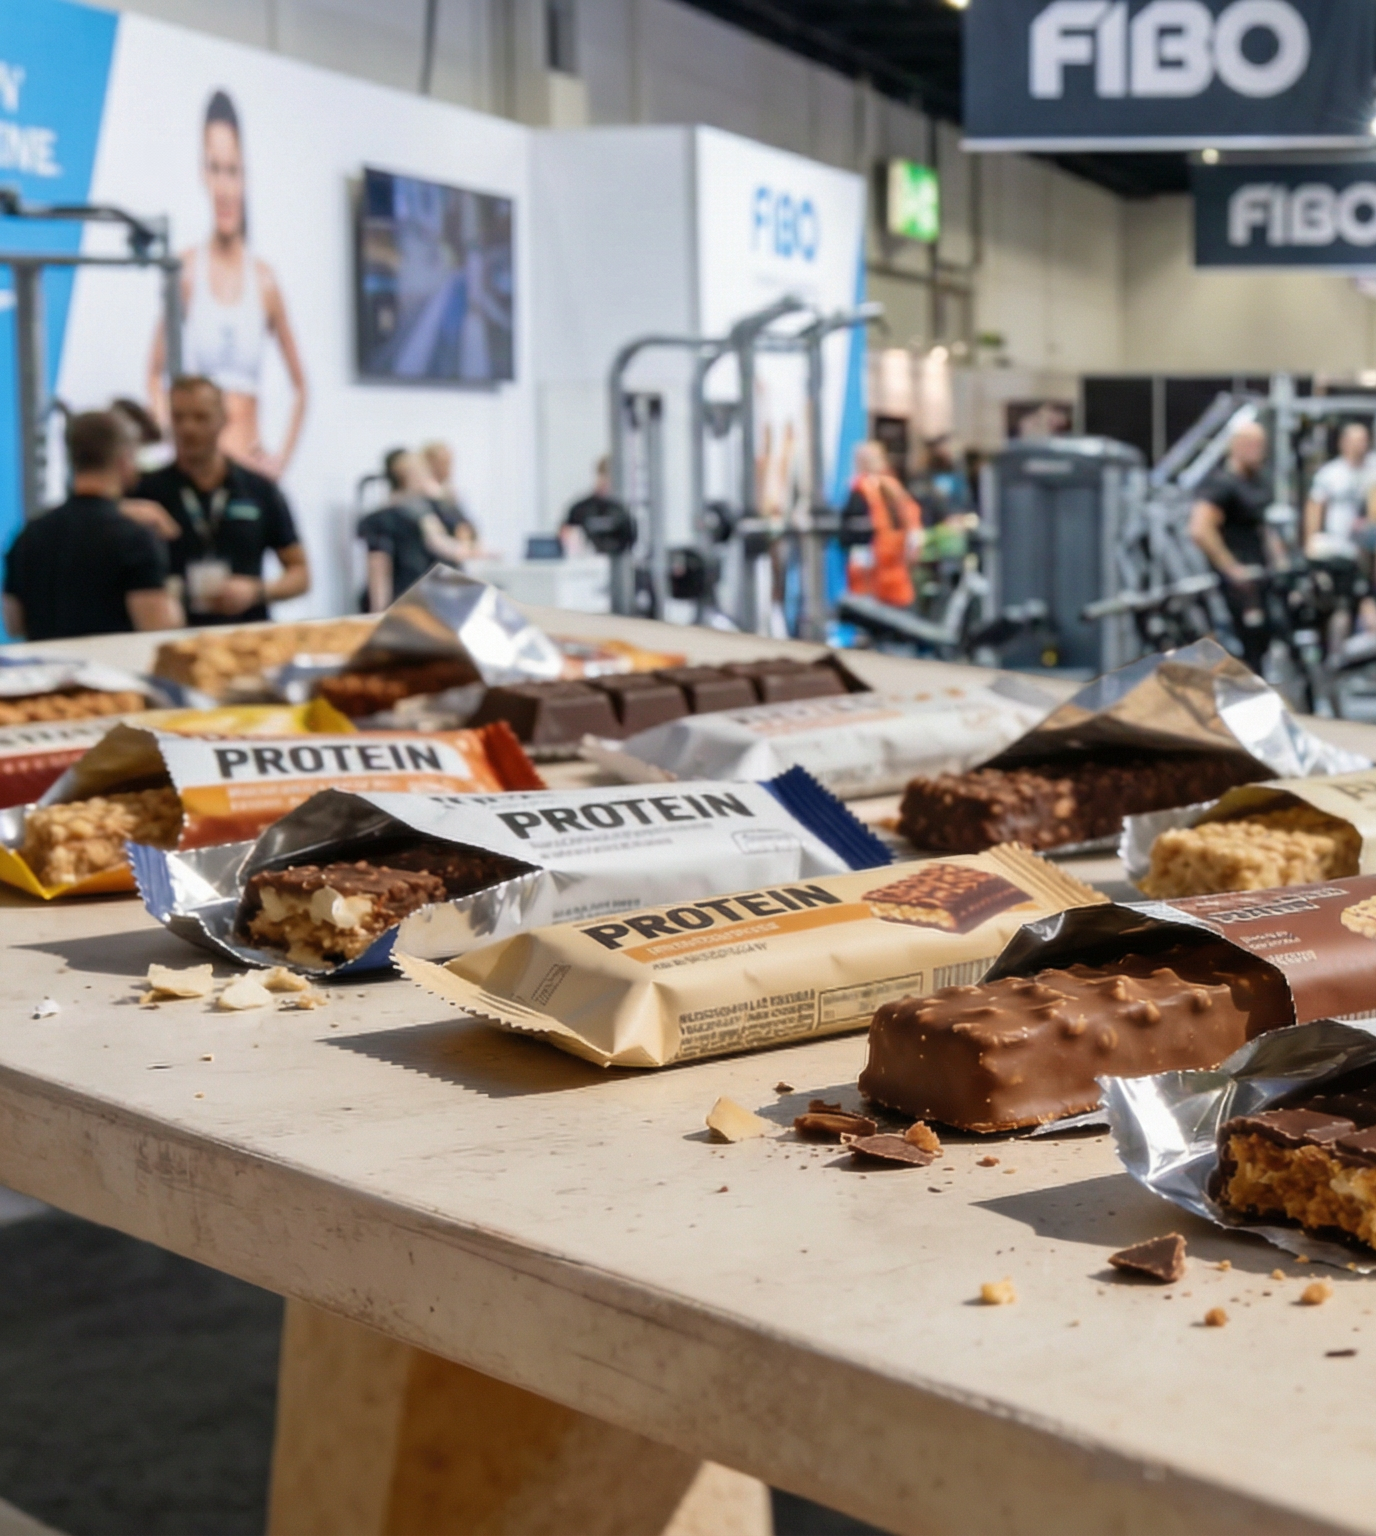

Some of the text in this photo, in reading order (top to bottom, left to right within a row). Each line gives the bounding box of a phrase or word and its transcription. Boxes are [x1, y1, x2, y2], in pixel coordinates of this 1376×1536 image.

[1028, 0, 1311, 99] FIBO
[751, 184, 822, 262] FIBO
[213, 742, 443, 779] PROTEIN
[497, 791, 755, 841] PROTEIN
[579, 884, 843, 951] PROTEIN
